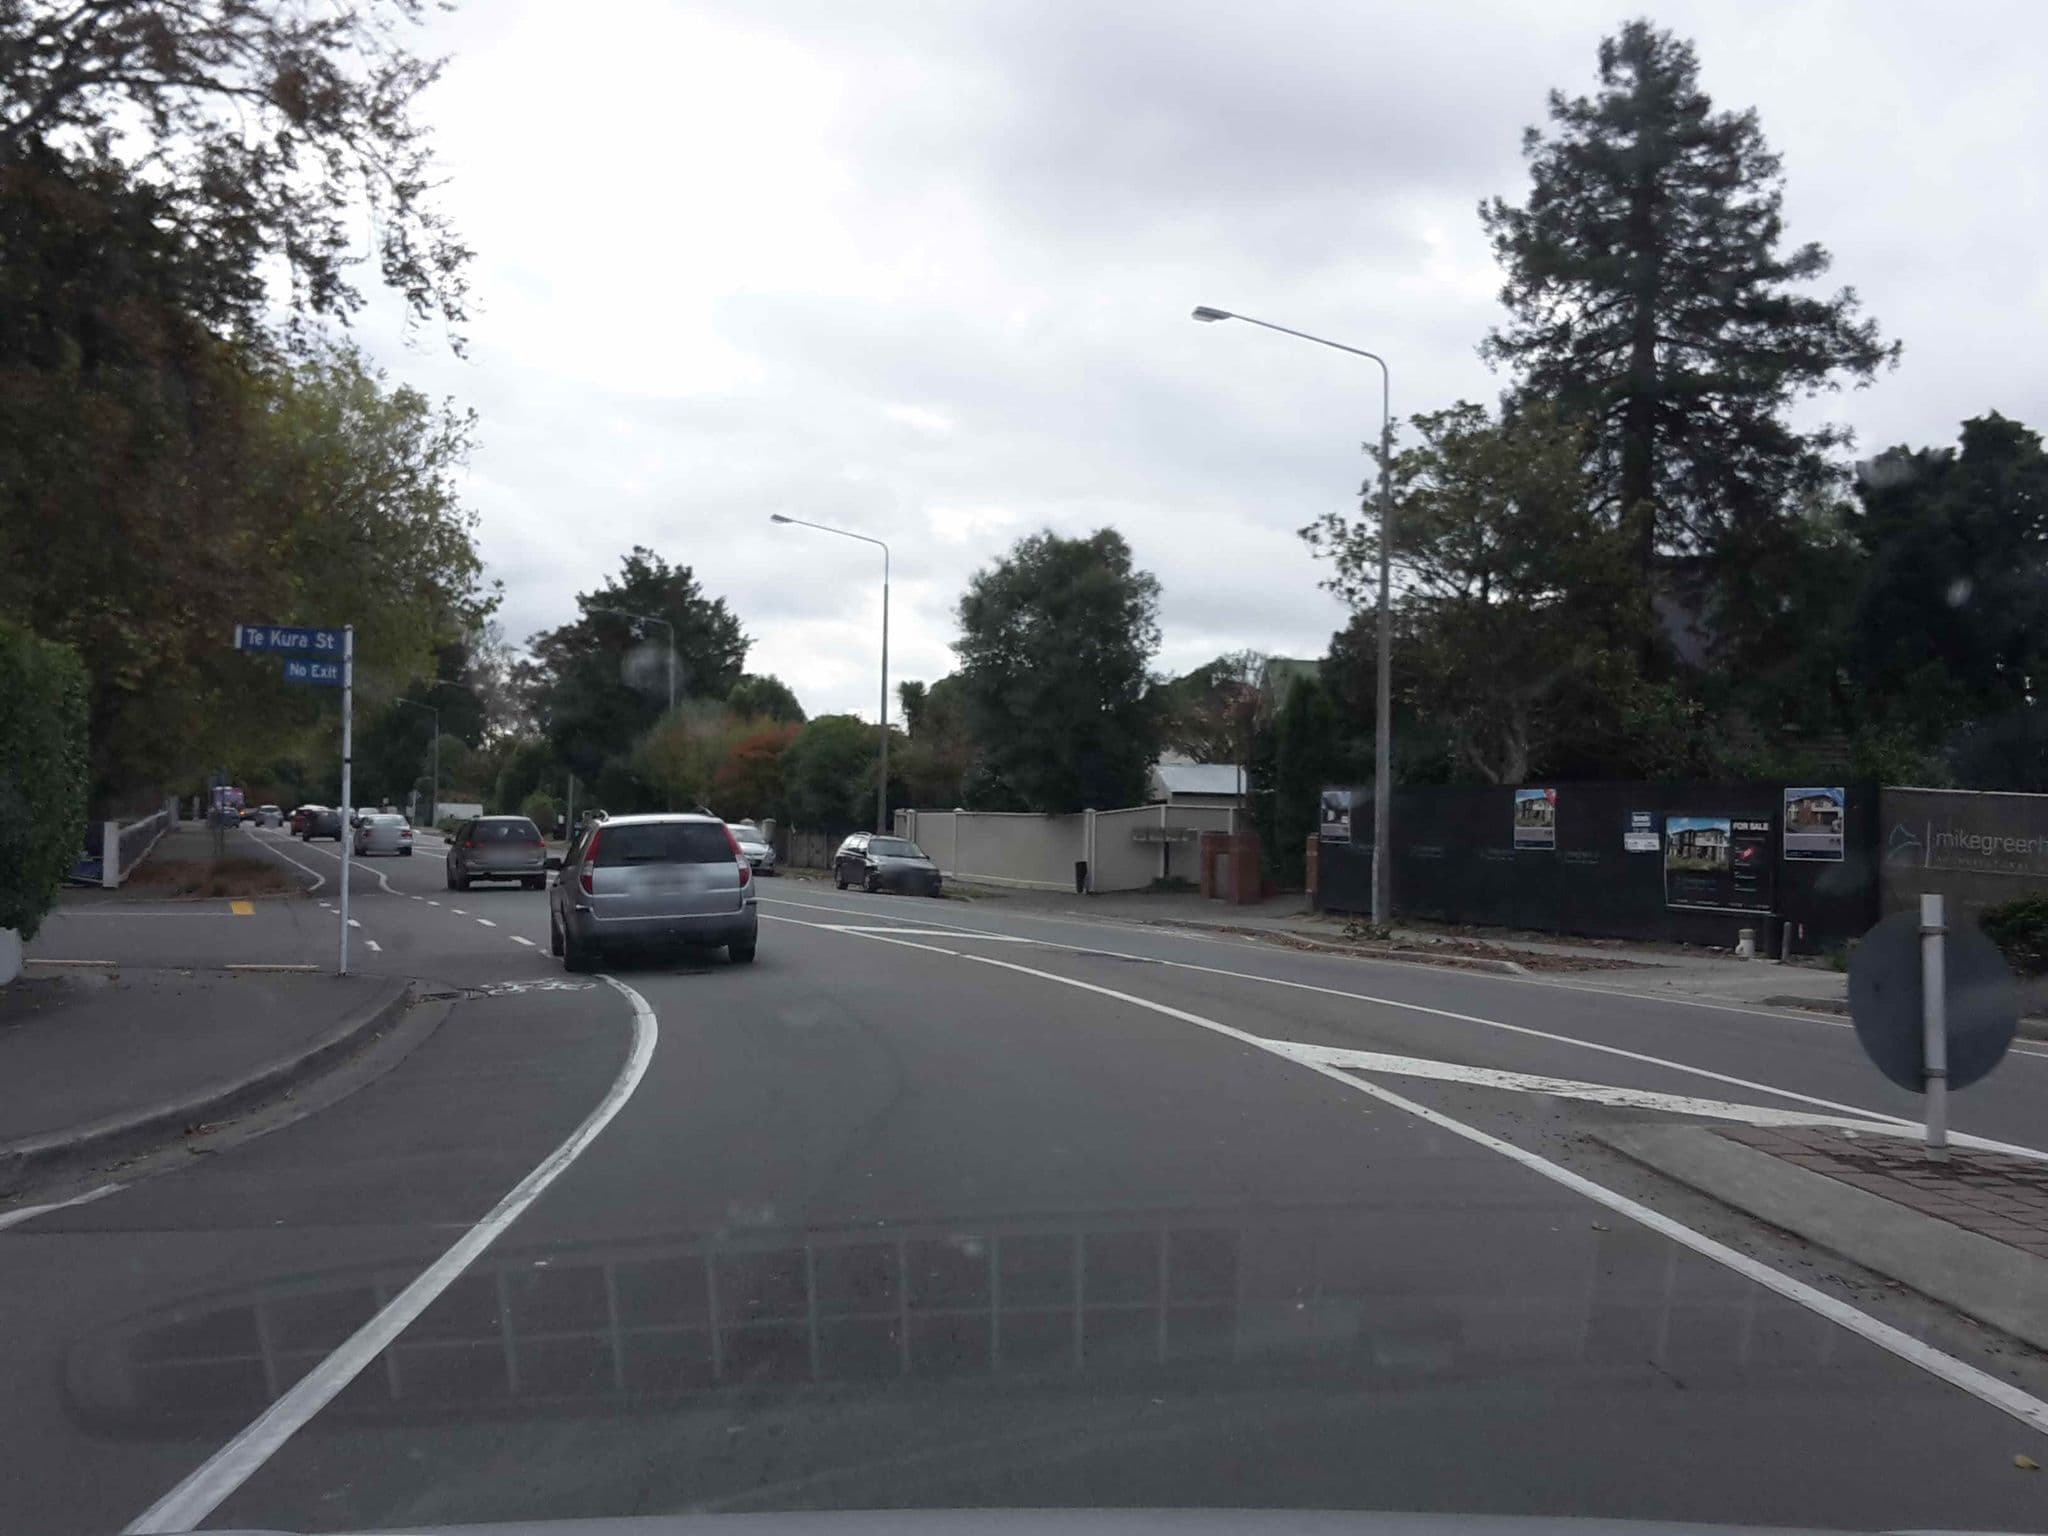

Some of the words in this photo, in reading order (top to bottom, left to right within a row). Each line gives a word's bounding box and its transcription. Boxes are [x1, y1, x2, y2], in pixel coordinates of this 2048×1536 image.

[247, 628, 264, 646] Te
[270, 630, 308, 648] Kura
[315, 632, 335, 650] St
[289, 662, 307, 677] No
[311, 663, 338, 679] Exit
